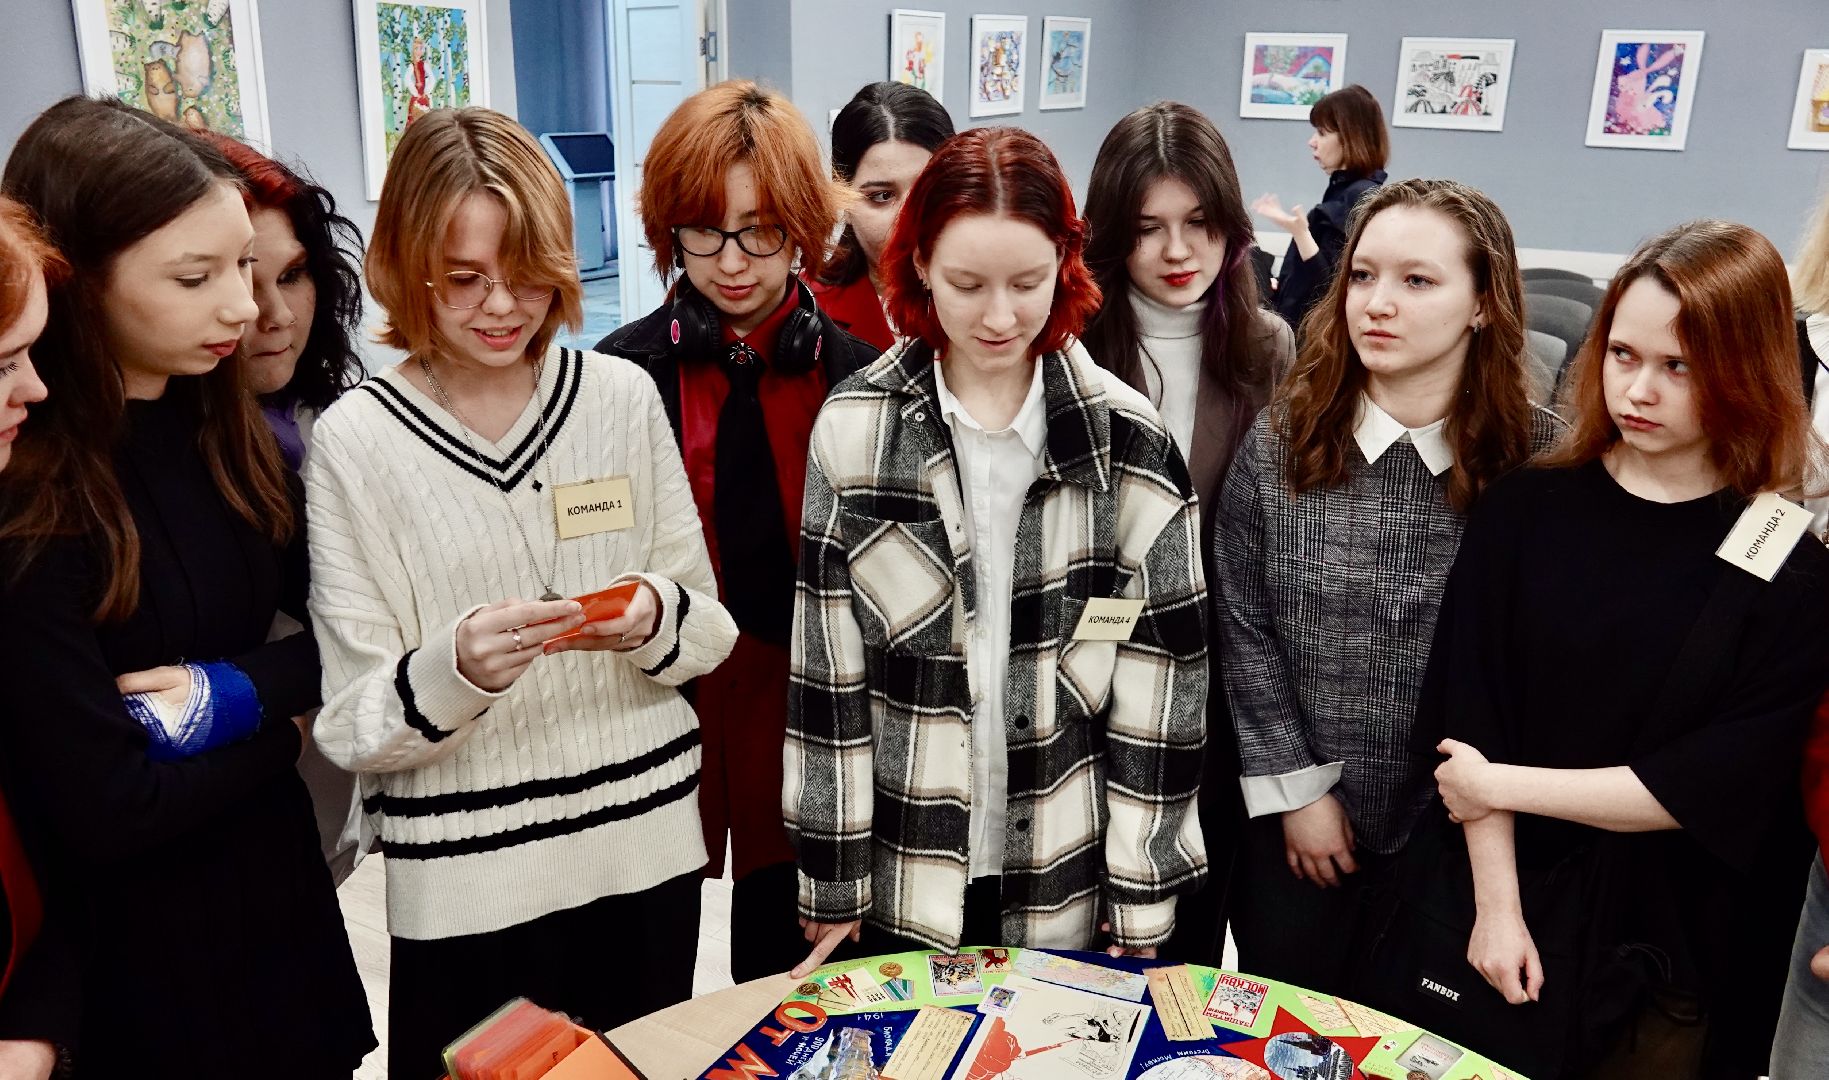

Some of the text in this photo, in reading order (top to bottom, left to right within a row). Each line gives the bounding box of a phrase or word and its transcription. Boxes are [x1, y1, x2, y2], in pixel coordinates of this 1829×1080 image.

[567, 500, 622, 516] КОМАНДА 1
[1745, 508, 1786, 560] КОМАНДА 2
[1088, 615, 1131, 624] КОМАНДА 4
[1221, 975, 1266, 995] МОСКВУ
[1421, 977, 1461, 1002] FANBOX
[857, 1012, 884, 1021] 1941
[811, 1036, 825, 1050] 900
